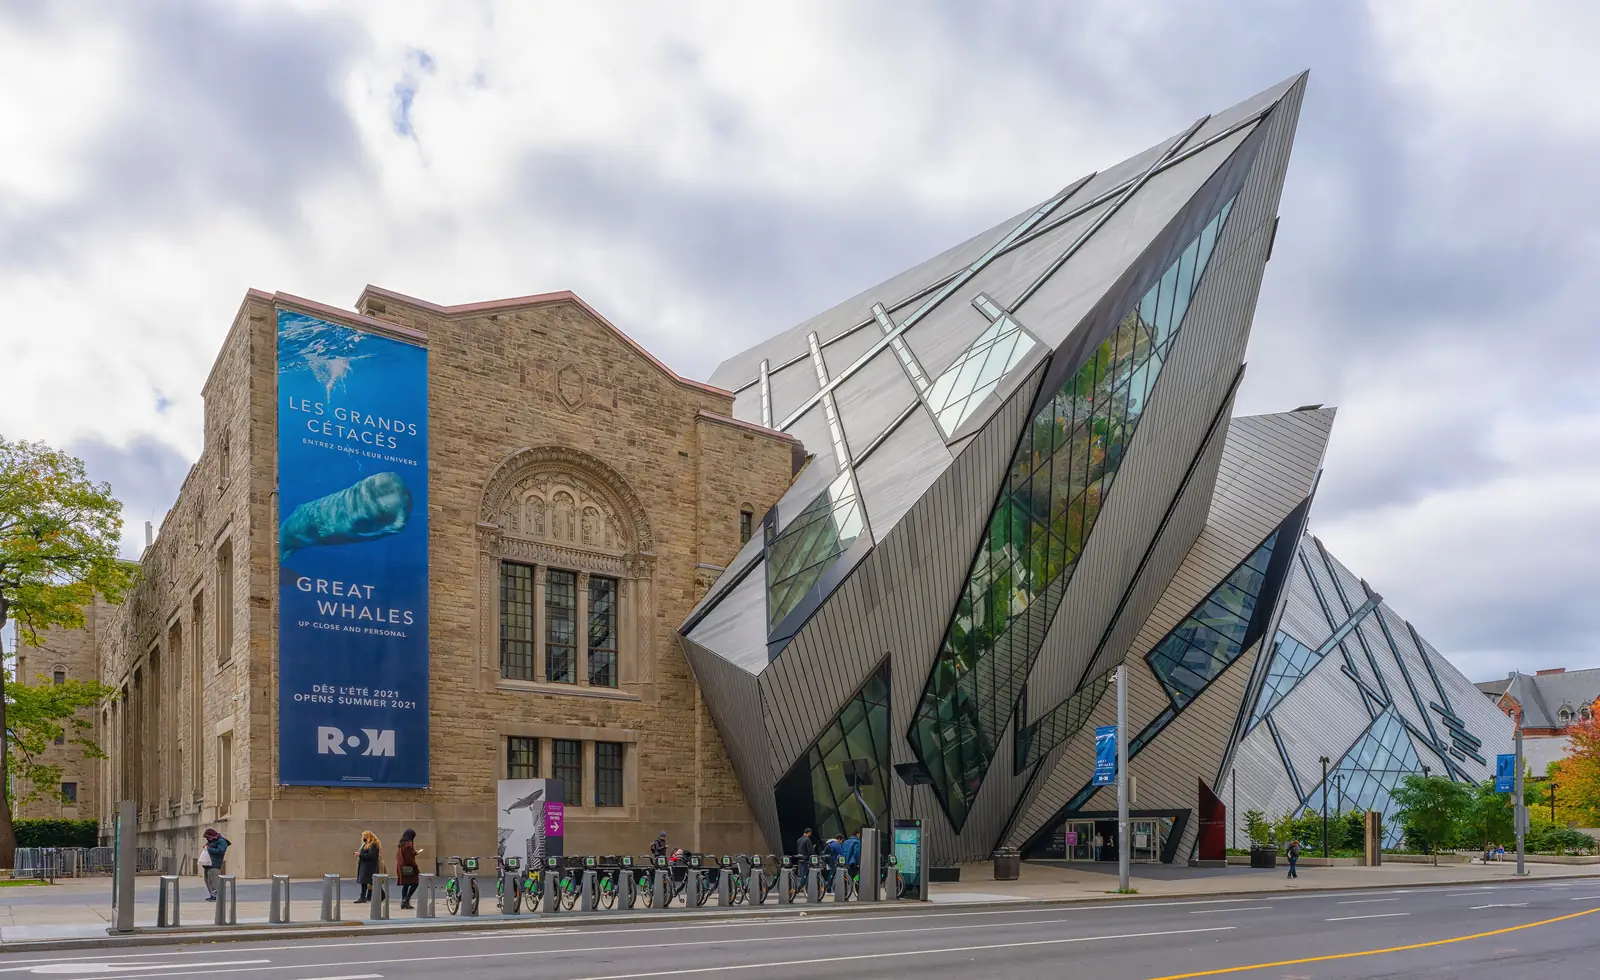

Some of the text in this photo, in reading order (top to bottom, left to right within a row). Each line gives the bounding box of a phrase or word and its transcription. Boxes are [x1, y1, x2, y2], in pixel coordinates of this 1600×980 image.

[289, 396, 417, 436] LES GRANDS
[307, 419, 397, 449] CÉTACÉS
[302, 437, 418, 467] ENTREZ DANS LEUR UNIVERS
[296, 576, 375, 600] GREAT
[317, 600, 414, 625] WHALES
[298, 620, 407, 638] UP CLOSE AND PERSONAL
[293, 693, 417, 709] OPENS SUMMER 2021
[312, 684, 399, 699] DÈS L'ÉTÉ 2021
